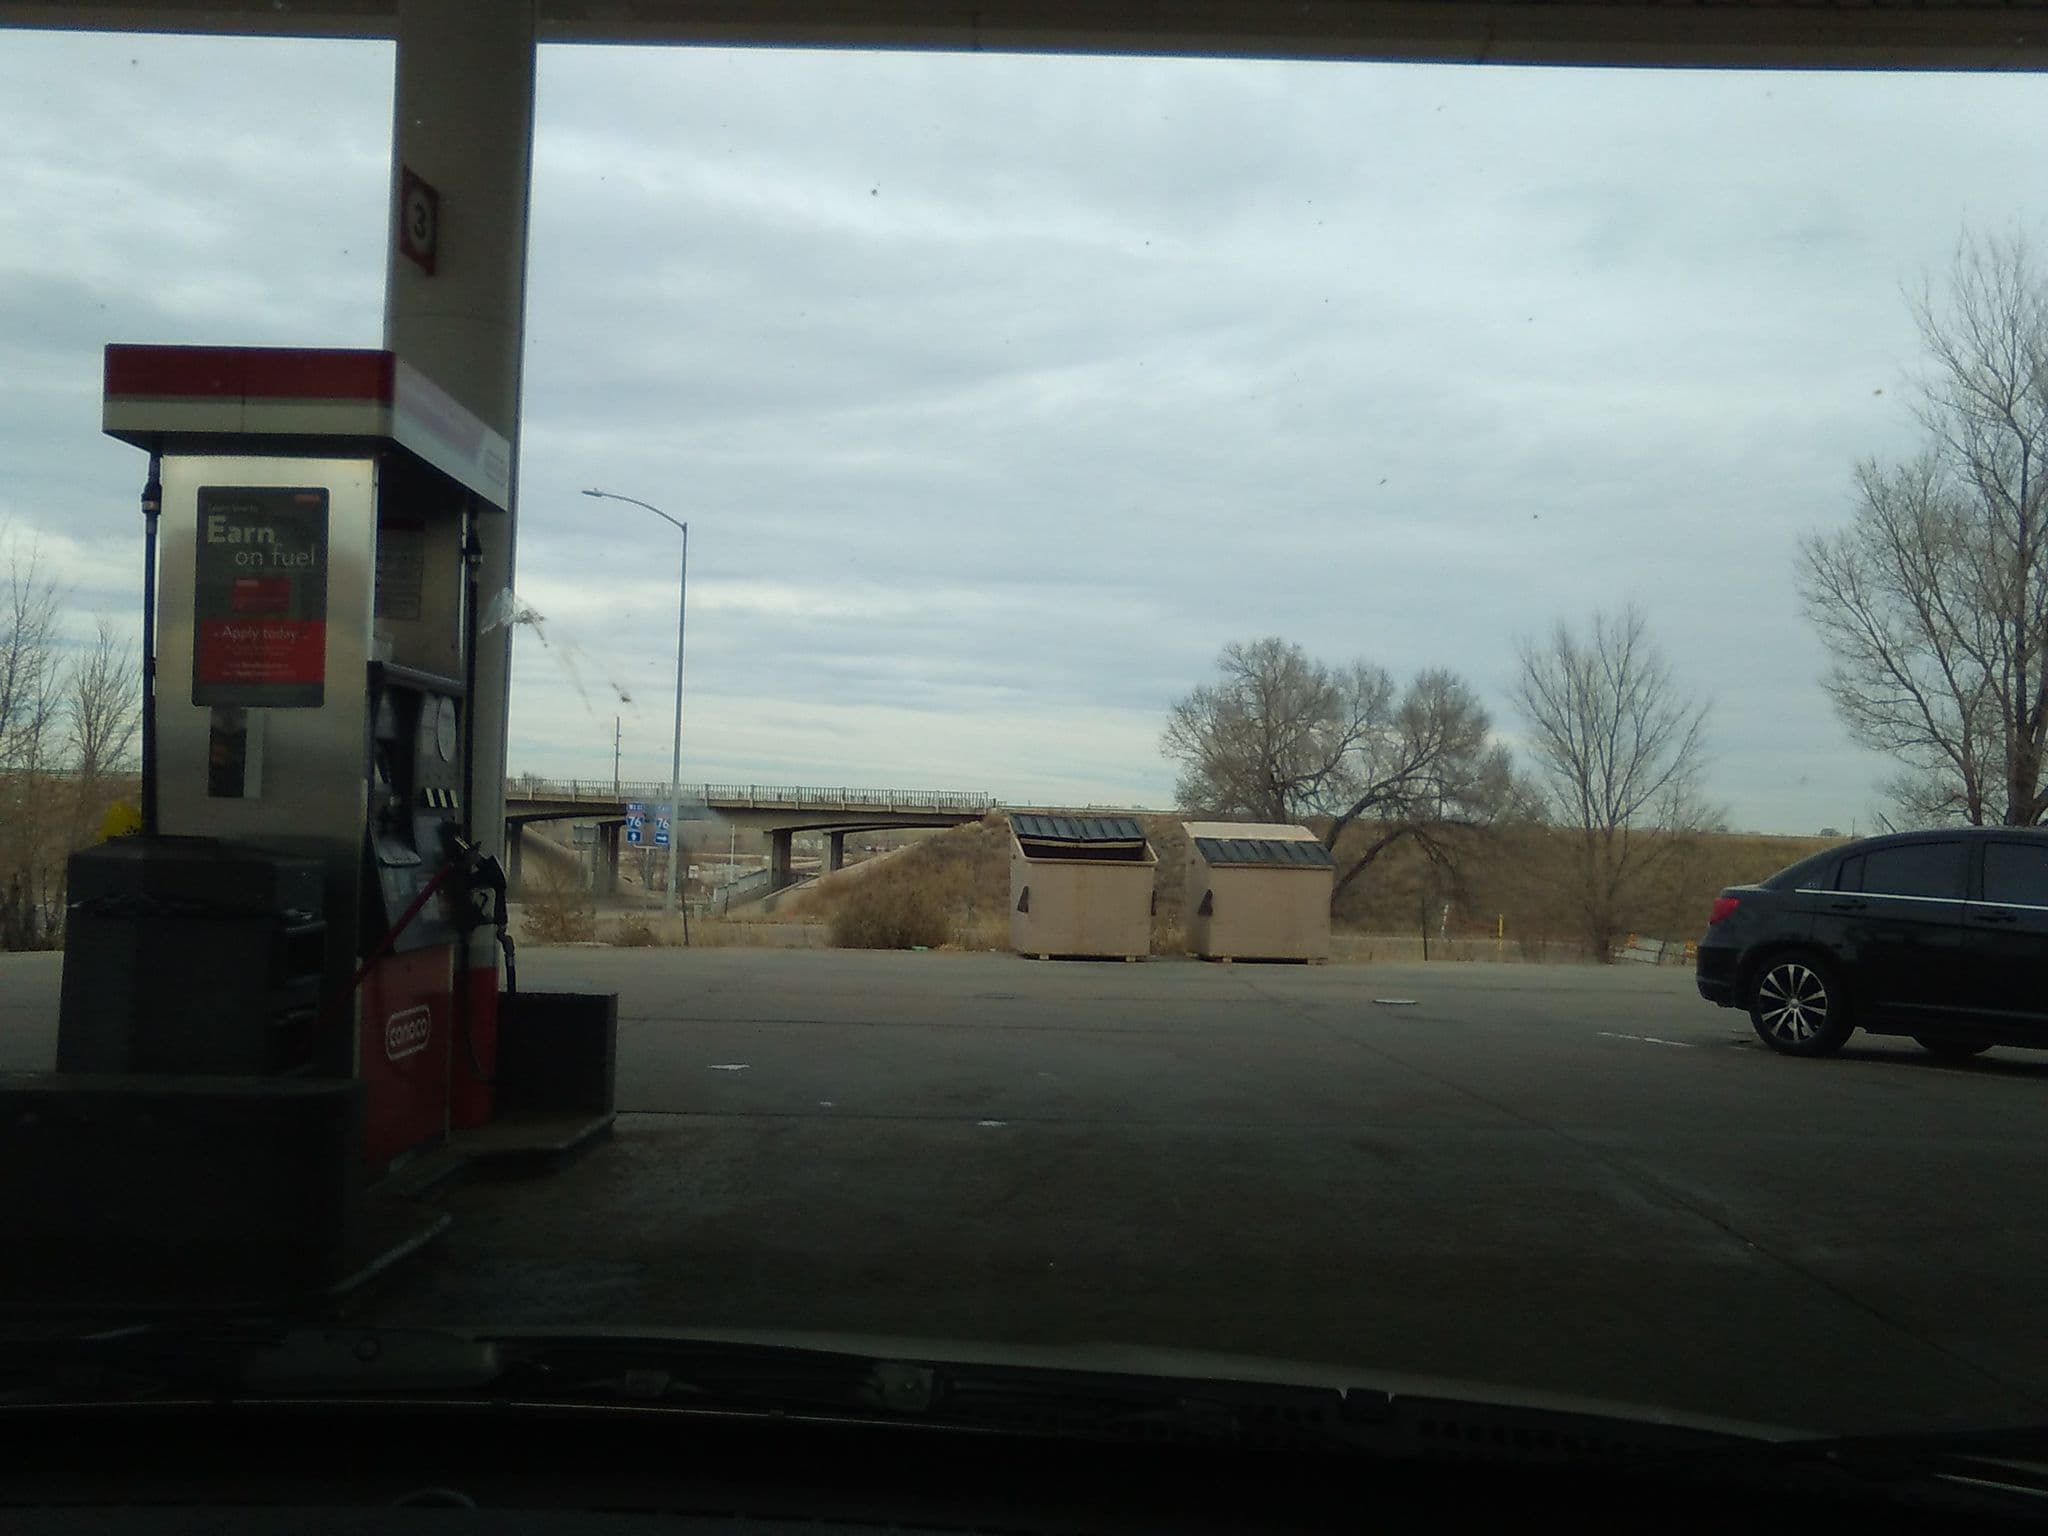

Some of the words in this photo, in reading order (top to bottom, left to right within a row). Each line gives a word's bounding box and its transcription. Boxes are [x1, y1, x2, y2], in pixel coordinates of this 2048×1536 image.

[414, 201, 426, 240] 3
[207, 514, 276, 544] Earn
[235, 552, 263, 566] on
[272, 543, 315, 566] fuel
[222, 625, 258, 642] Apply
[263, 625, 296, 644] today
[628, 816, 642, 828] 76
[657, 817, 670, 829] 76
